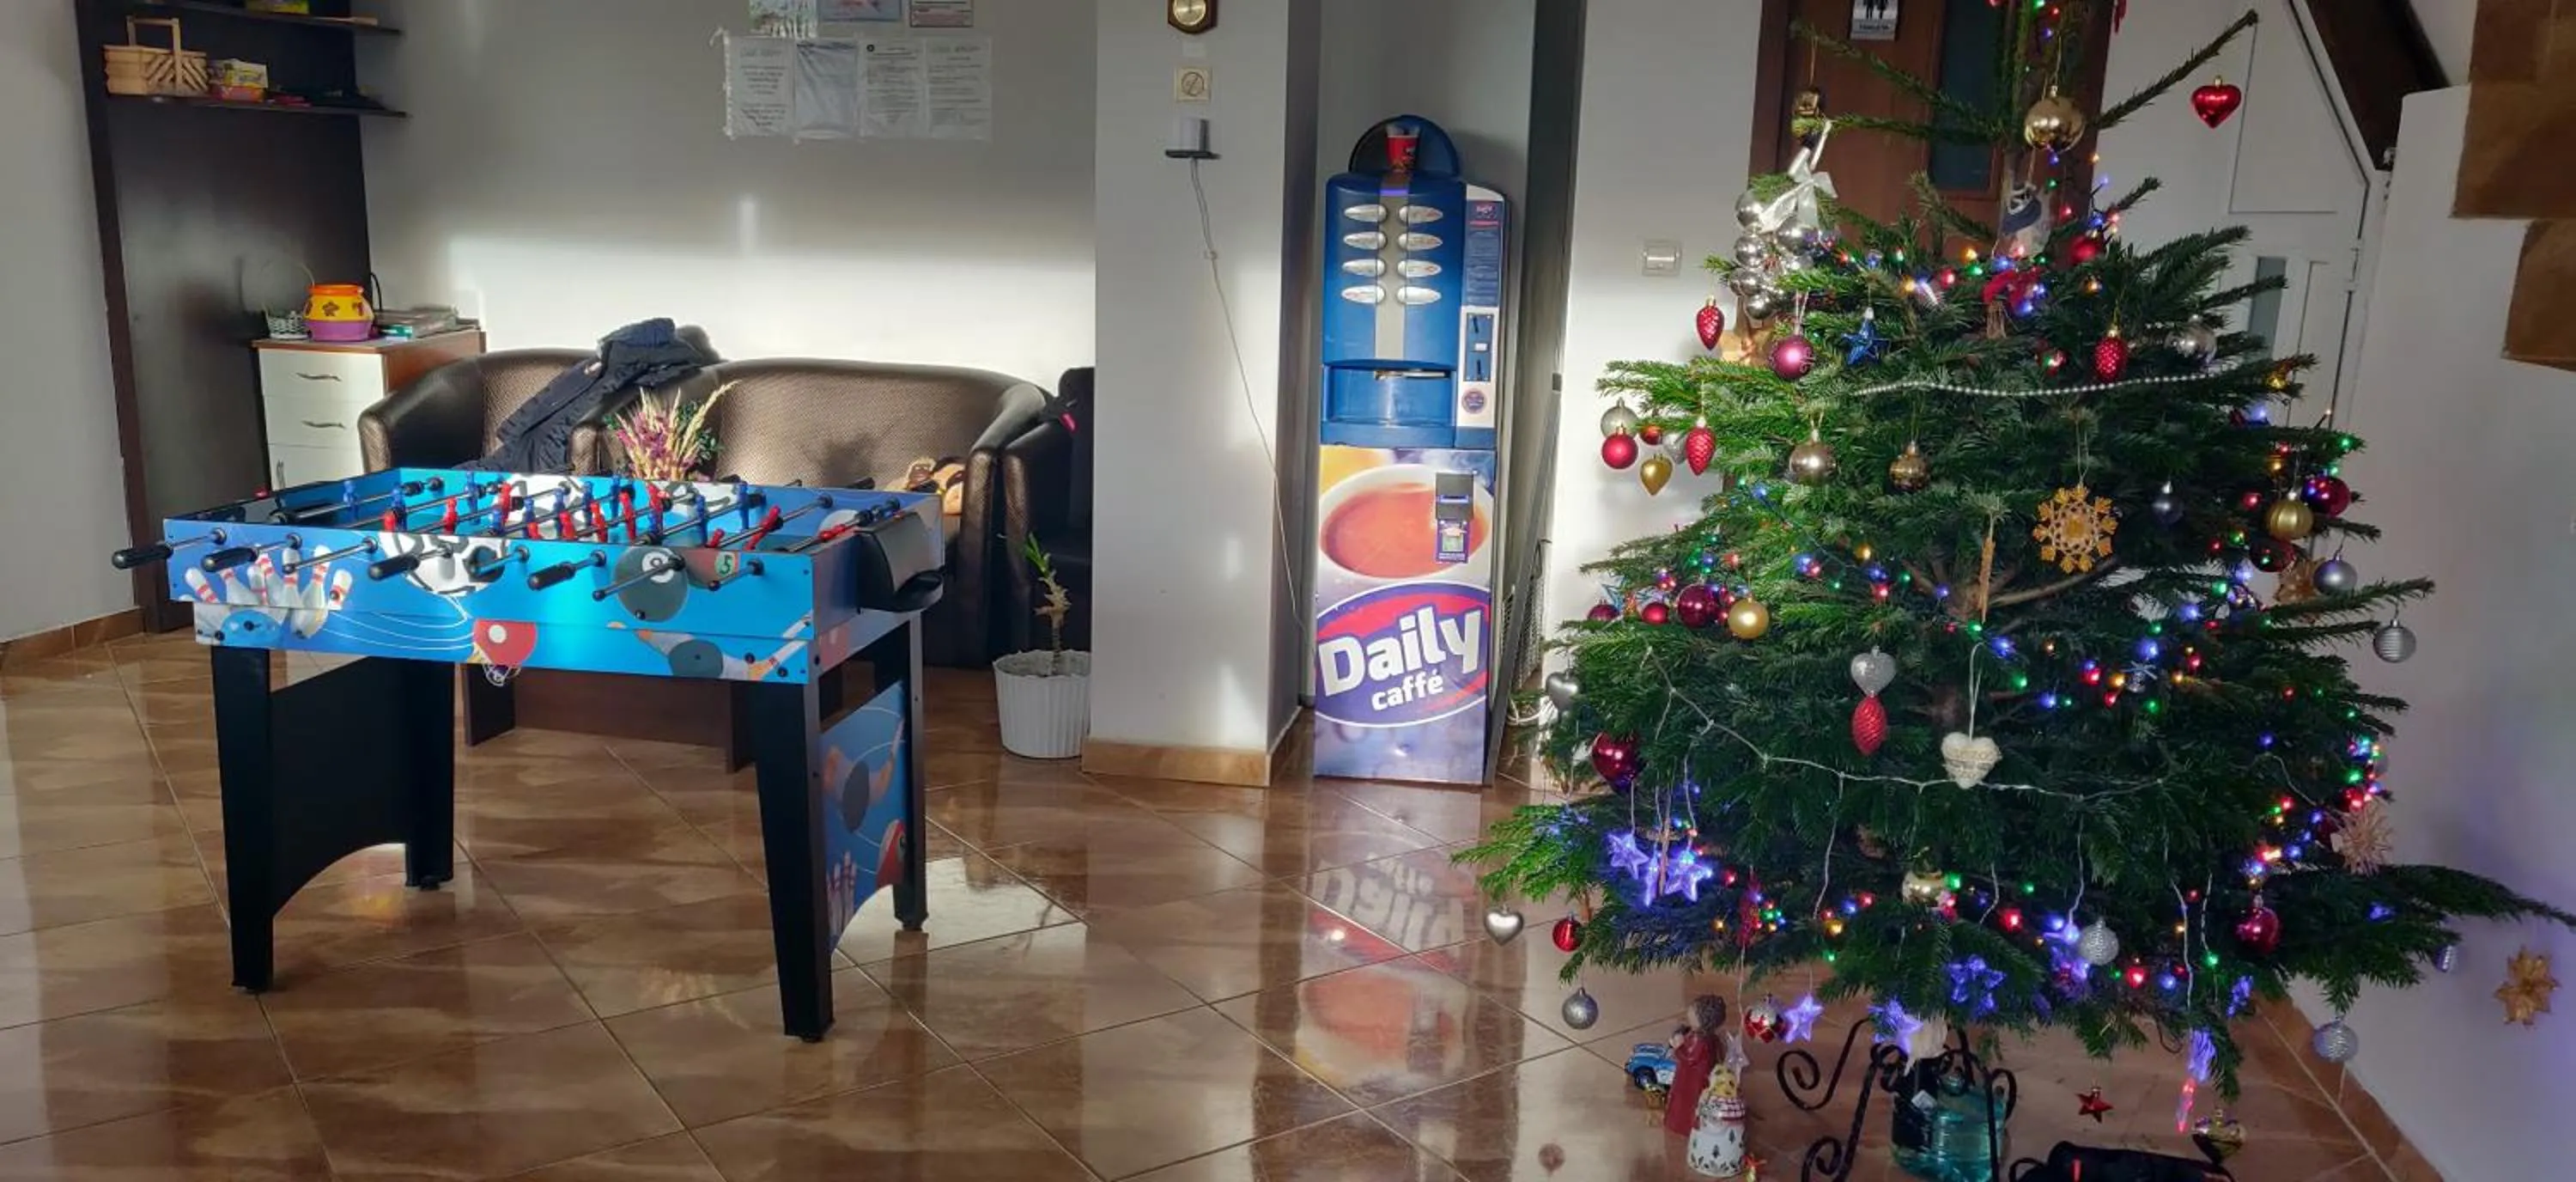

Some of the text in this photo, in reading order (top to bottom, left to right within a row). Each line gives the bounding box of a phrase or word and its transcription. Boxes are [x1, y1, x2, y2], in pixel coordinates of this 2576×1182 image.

[719, 554, 733, 576] 5
[1318, 606, 1481, 697] Daily
[1371, 668, 1443, 711] caffé
